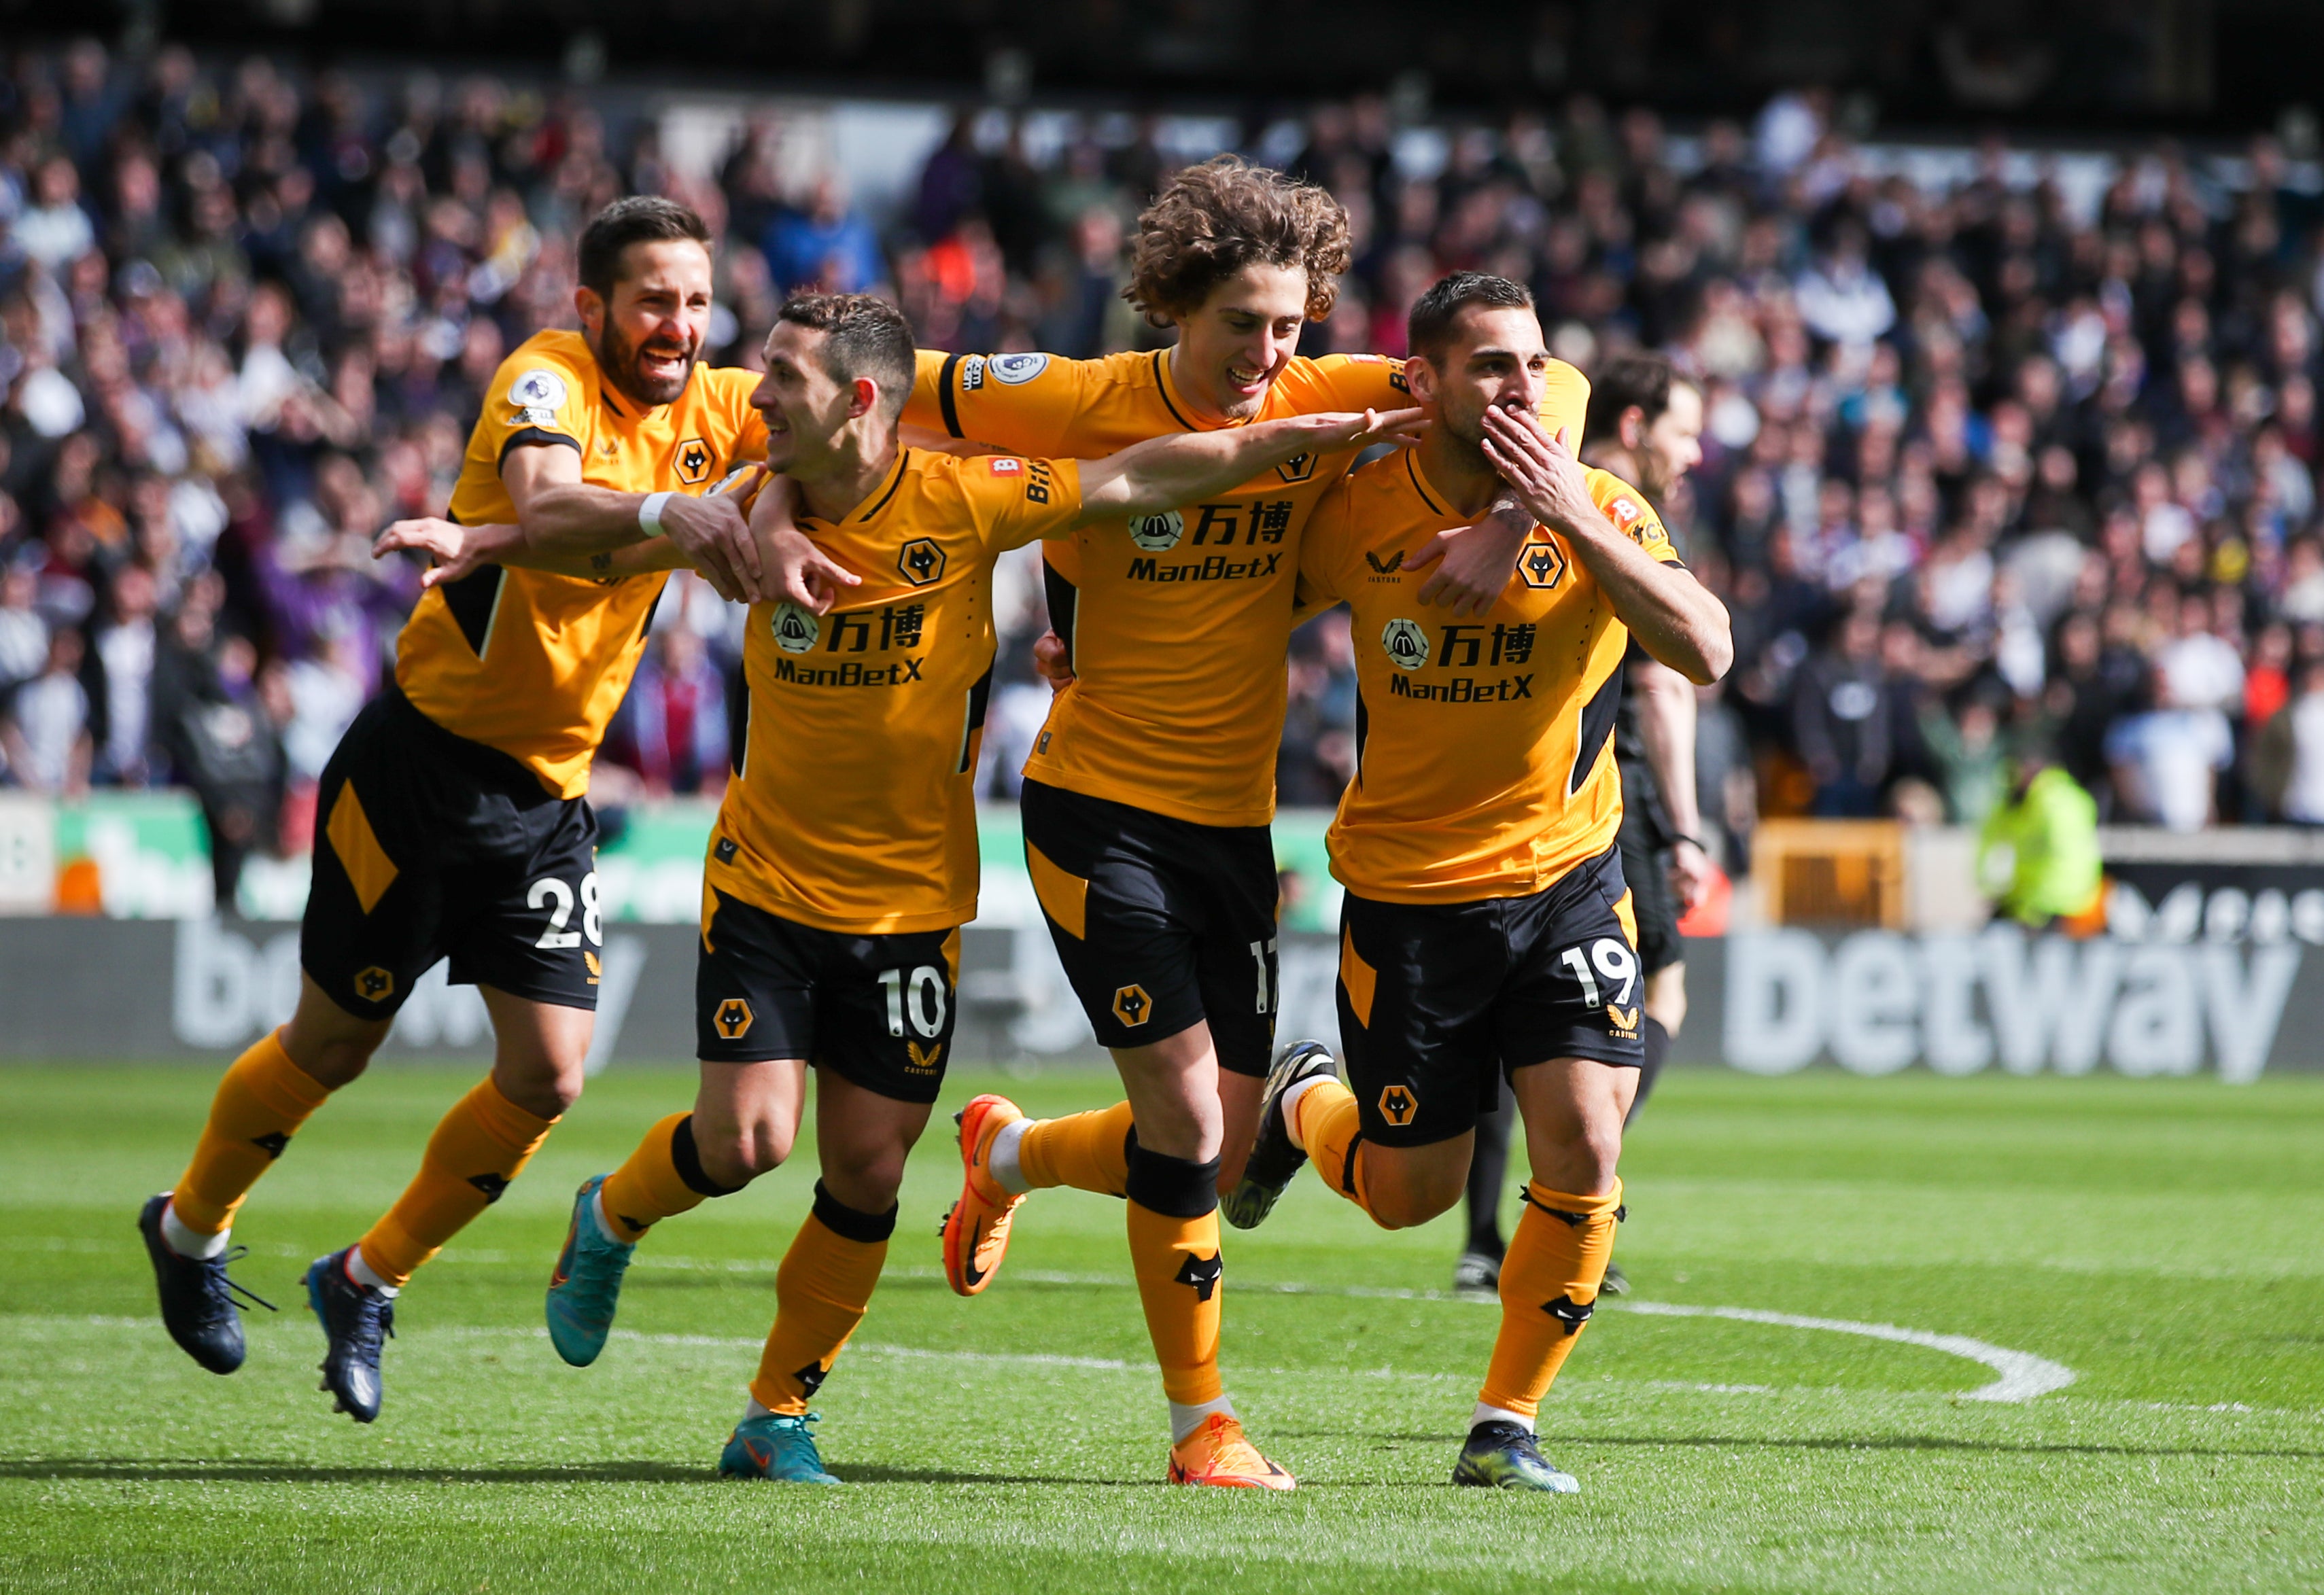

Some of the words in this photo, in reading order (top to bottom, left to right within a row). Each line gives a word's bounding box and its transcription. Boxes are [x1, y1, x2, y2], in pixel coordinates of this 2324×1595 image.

[1192, 501, 1293, 545] 万博
[1127, 552, 1283, 582] ManBetX
[826, 604, 924, 652] 万博
[1438, 624, 1537, 667] 万博
[774, 656, 924, 686] ManBetX
[1391, 673, 1534, 703] ManBetX
[527, 871, 604, 949] 28
[1561, 937, 1637, 1009] 19
[877, 965, 946, 1038] 10
[1723, 921, 2304, 1086] betway
